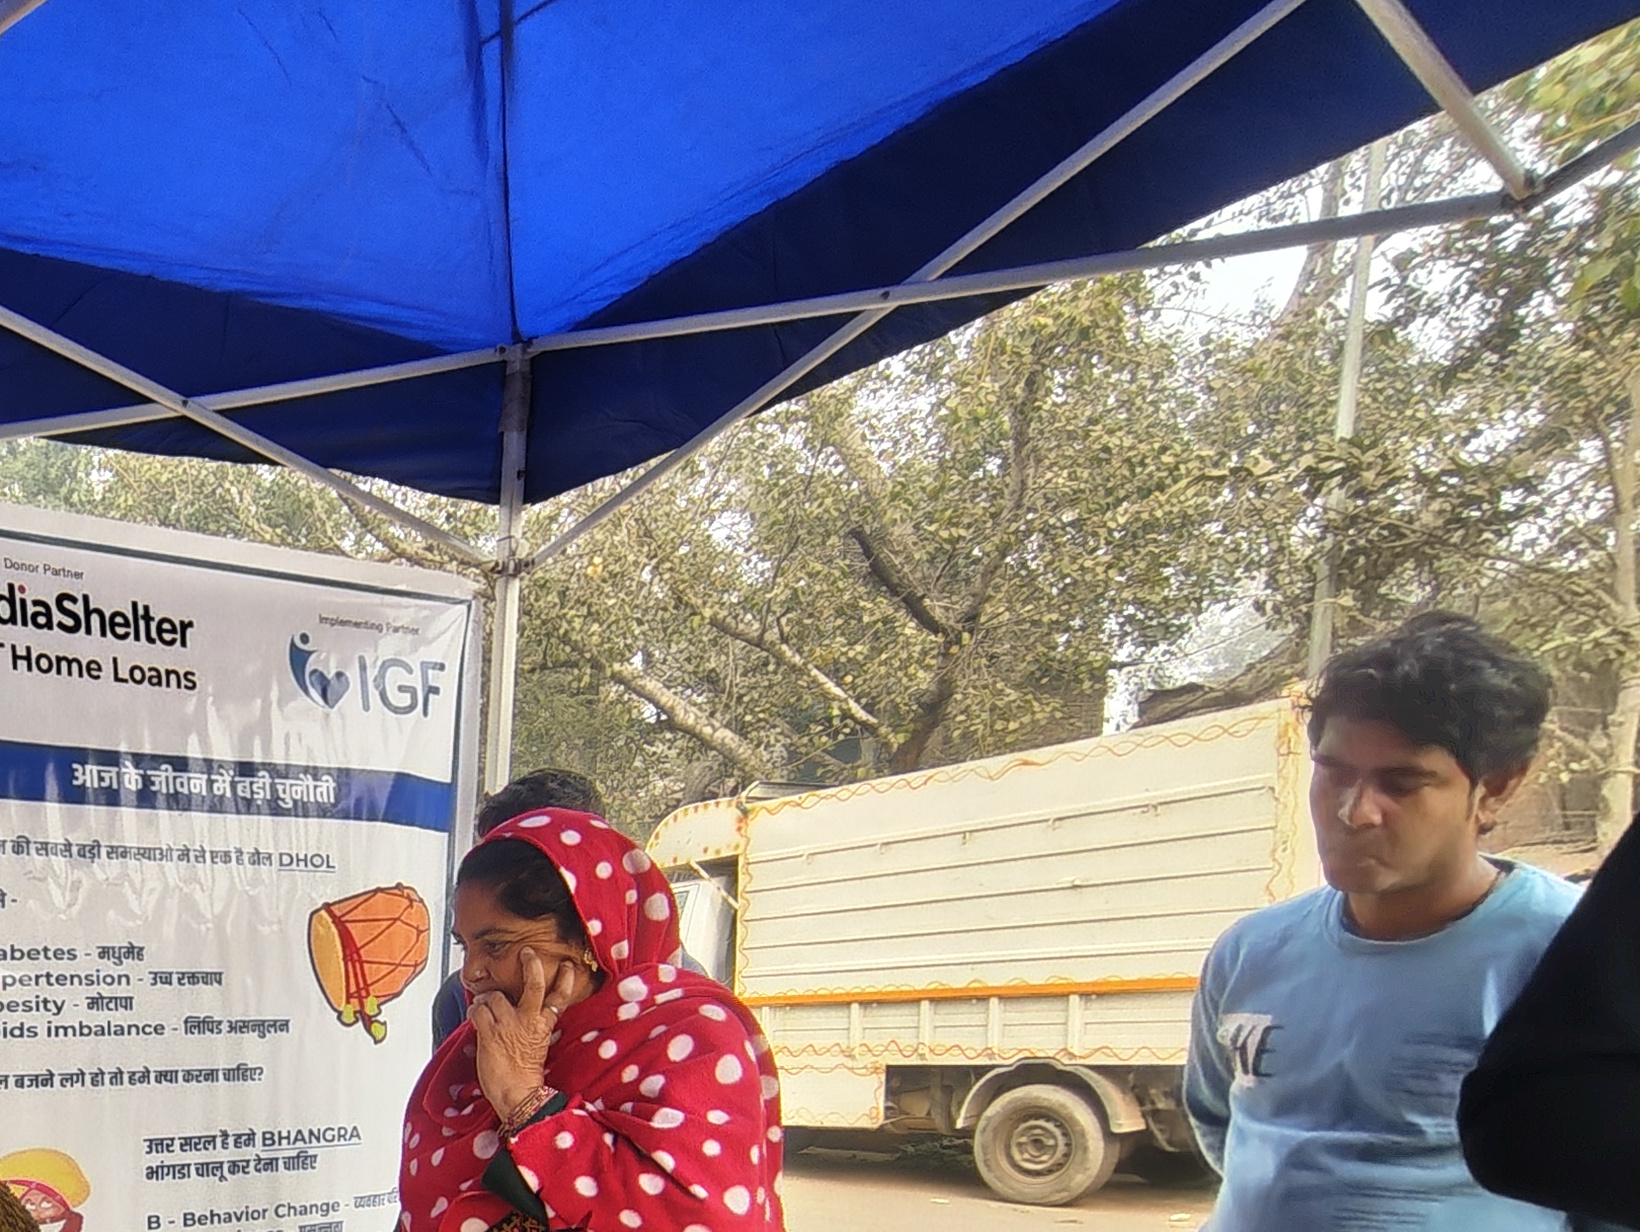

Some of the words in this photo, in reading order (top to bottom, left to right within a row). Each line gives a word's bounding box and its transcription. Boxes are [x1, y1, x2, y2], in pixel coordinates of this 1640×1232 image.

[3, 557, 40, 575] Donor
[43, 563, 85, 581] Partner
[318, 613, 384, 634] Implementing
[386, 619, 421, 636] Partner
[11, 643, 103, 681] Home
[112, 656, 197, 691] Loans
[358, 654, 446, 718] IGF
[276, 774, 336, 808] चुनौती
[279, 852, 336, 869] DHOL
[47, 1020, 165, 1038] imbalance
[261, 1126, 362, 1148] BHANGRA
[147, 1215, 161, 1230] B
[183, 1206, 269, 1228] Behavior
[274, 1199, 340, 1218] Change
